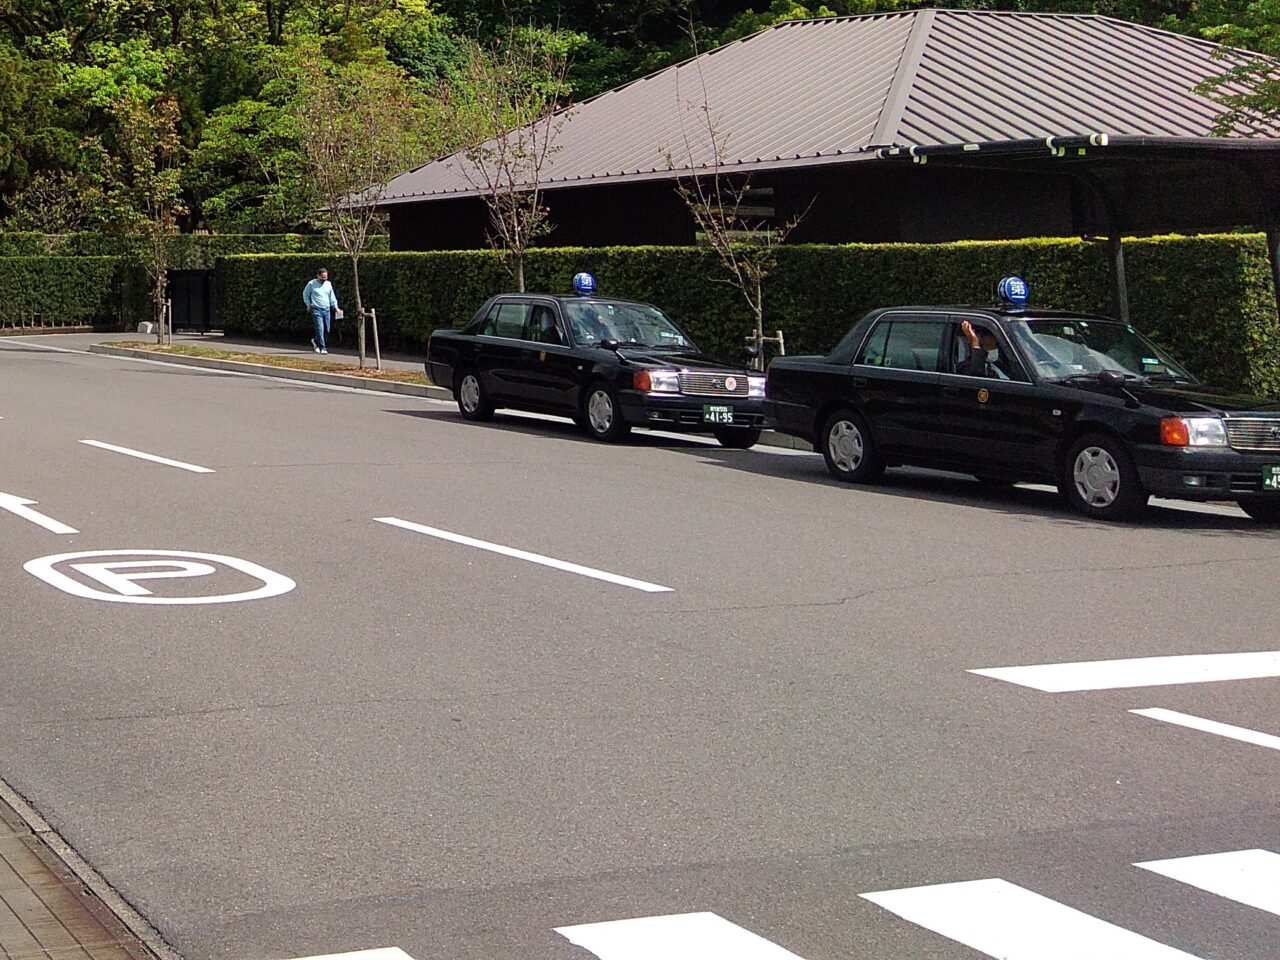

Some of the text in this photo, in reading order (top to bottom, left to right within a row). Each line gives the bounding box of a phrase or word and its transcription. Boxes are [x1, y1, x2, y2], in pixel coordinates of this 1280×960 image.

[1010, 280, 1026, 299] 第一
[710, 411, 733, 423] 41-95
[69, 560, 216, 596] P
